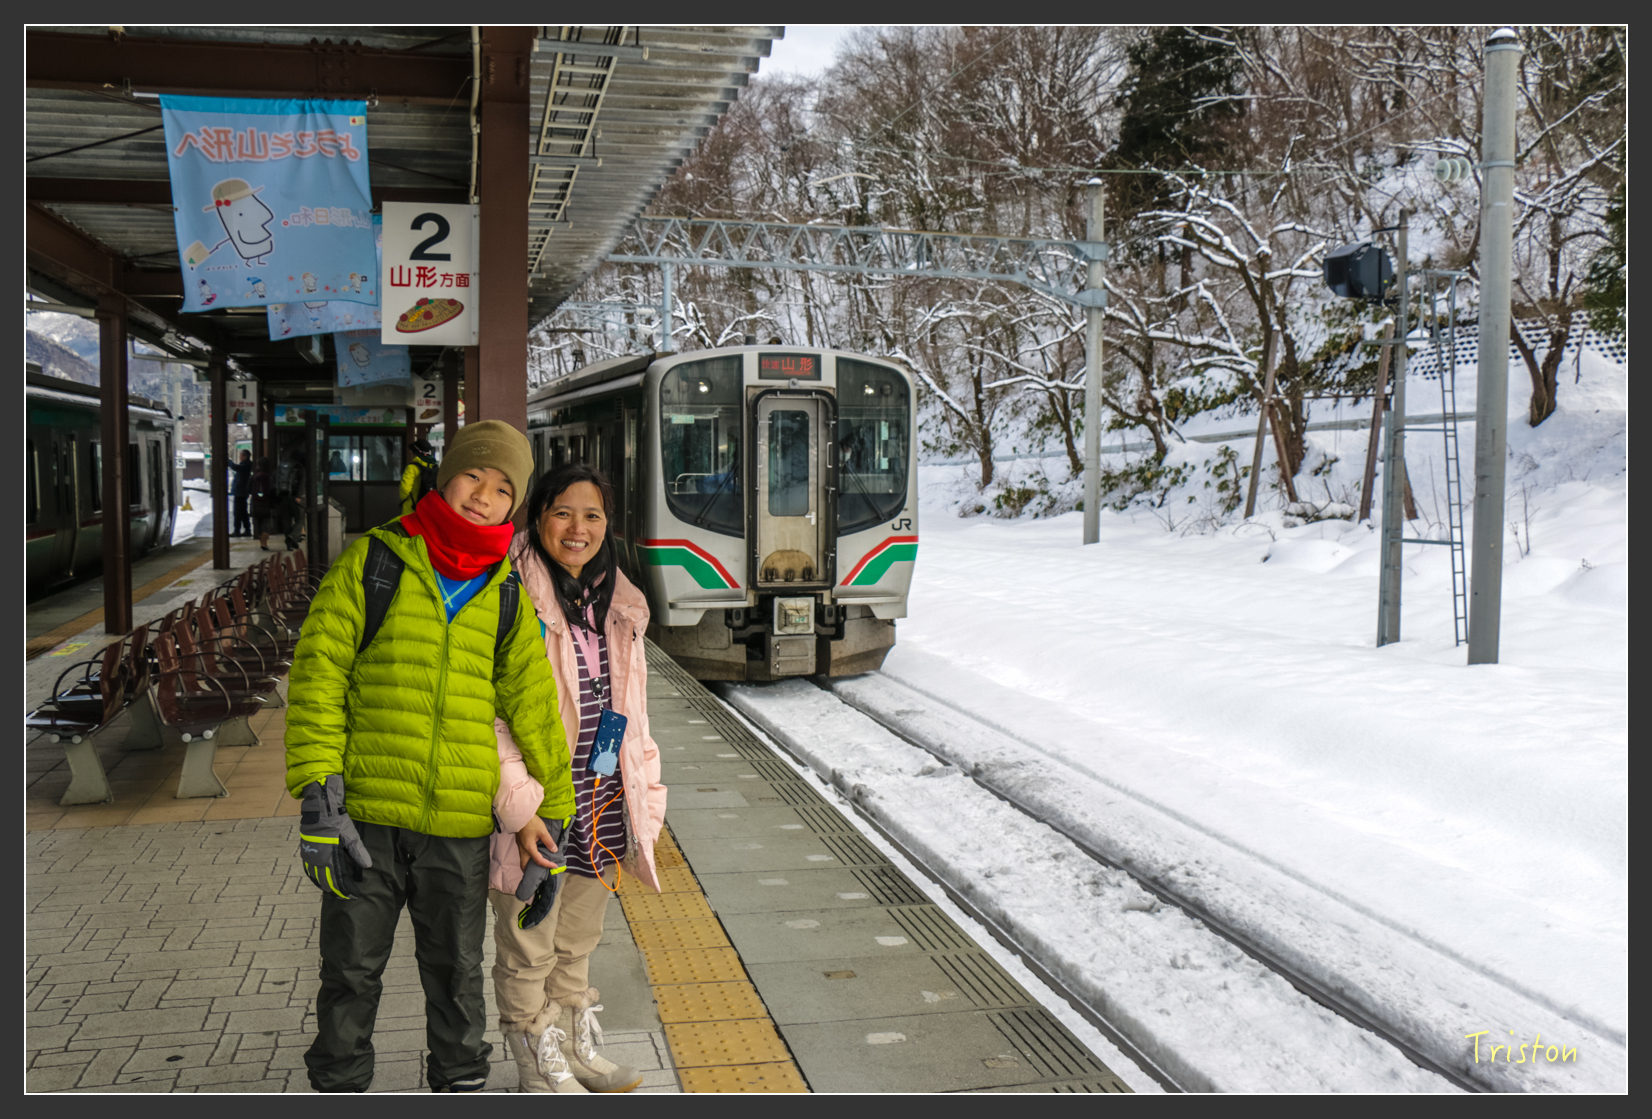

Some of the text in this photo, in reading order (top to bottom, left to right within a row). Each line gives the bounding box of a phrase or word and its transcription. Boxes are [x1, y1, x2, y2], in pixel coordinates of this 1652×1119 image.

[409, 212, 451, 262] 2
[390, 265, 470, 289] 山形方面
[781, 356, 814, 371] 山形
[237, 383, 247, 399] 1
[423, 382, 436, 398] 2
[891, 518, 912, 531] JR
